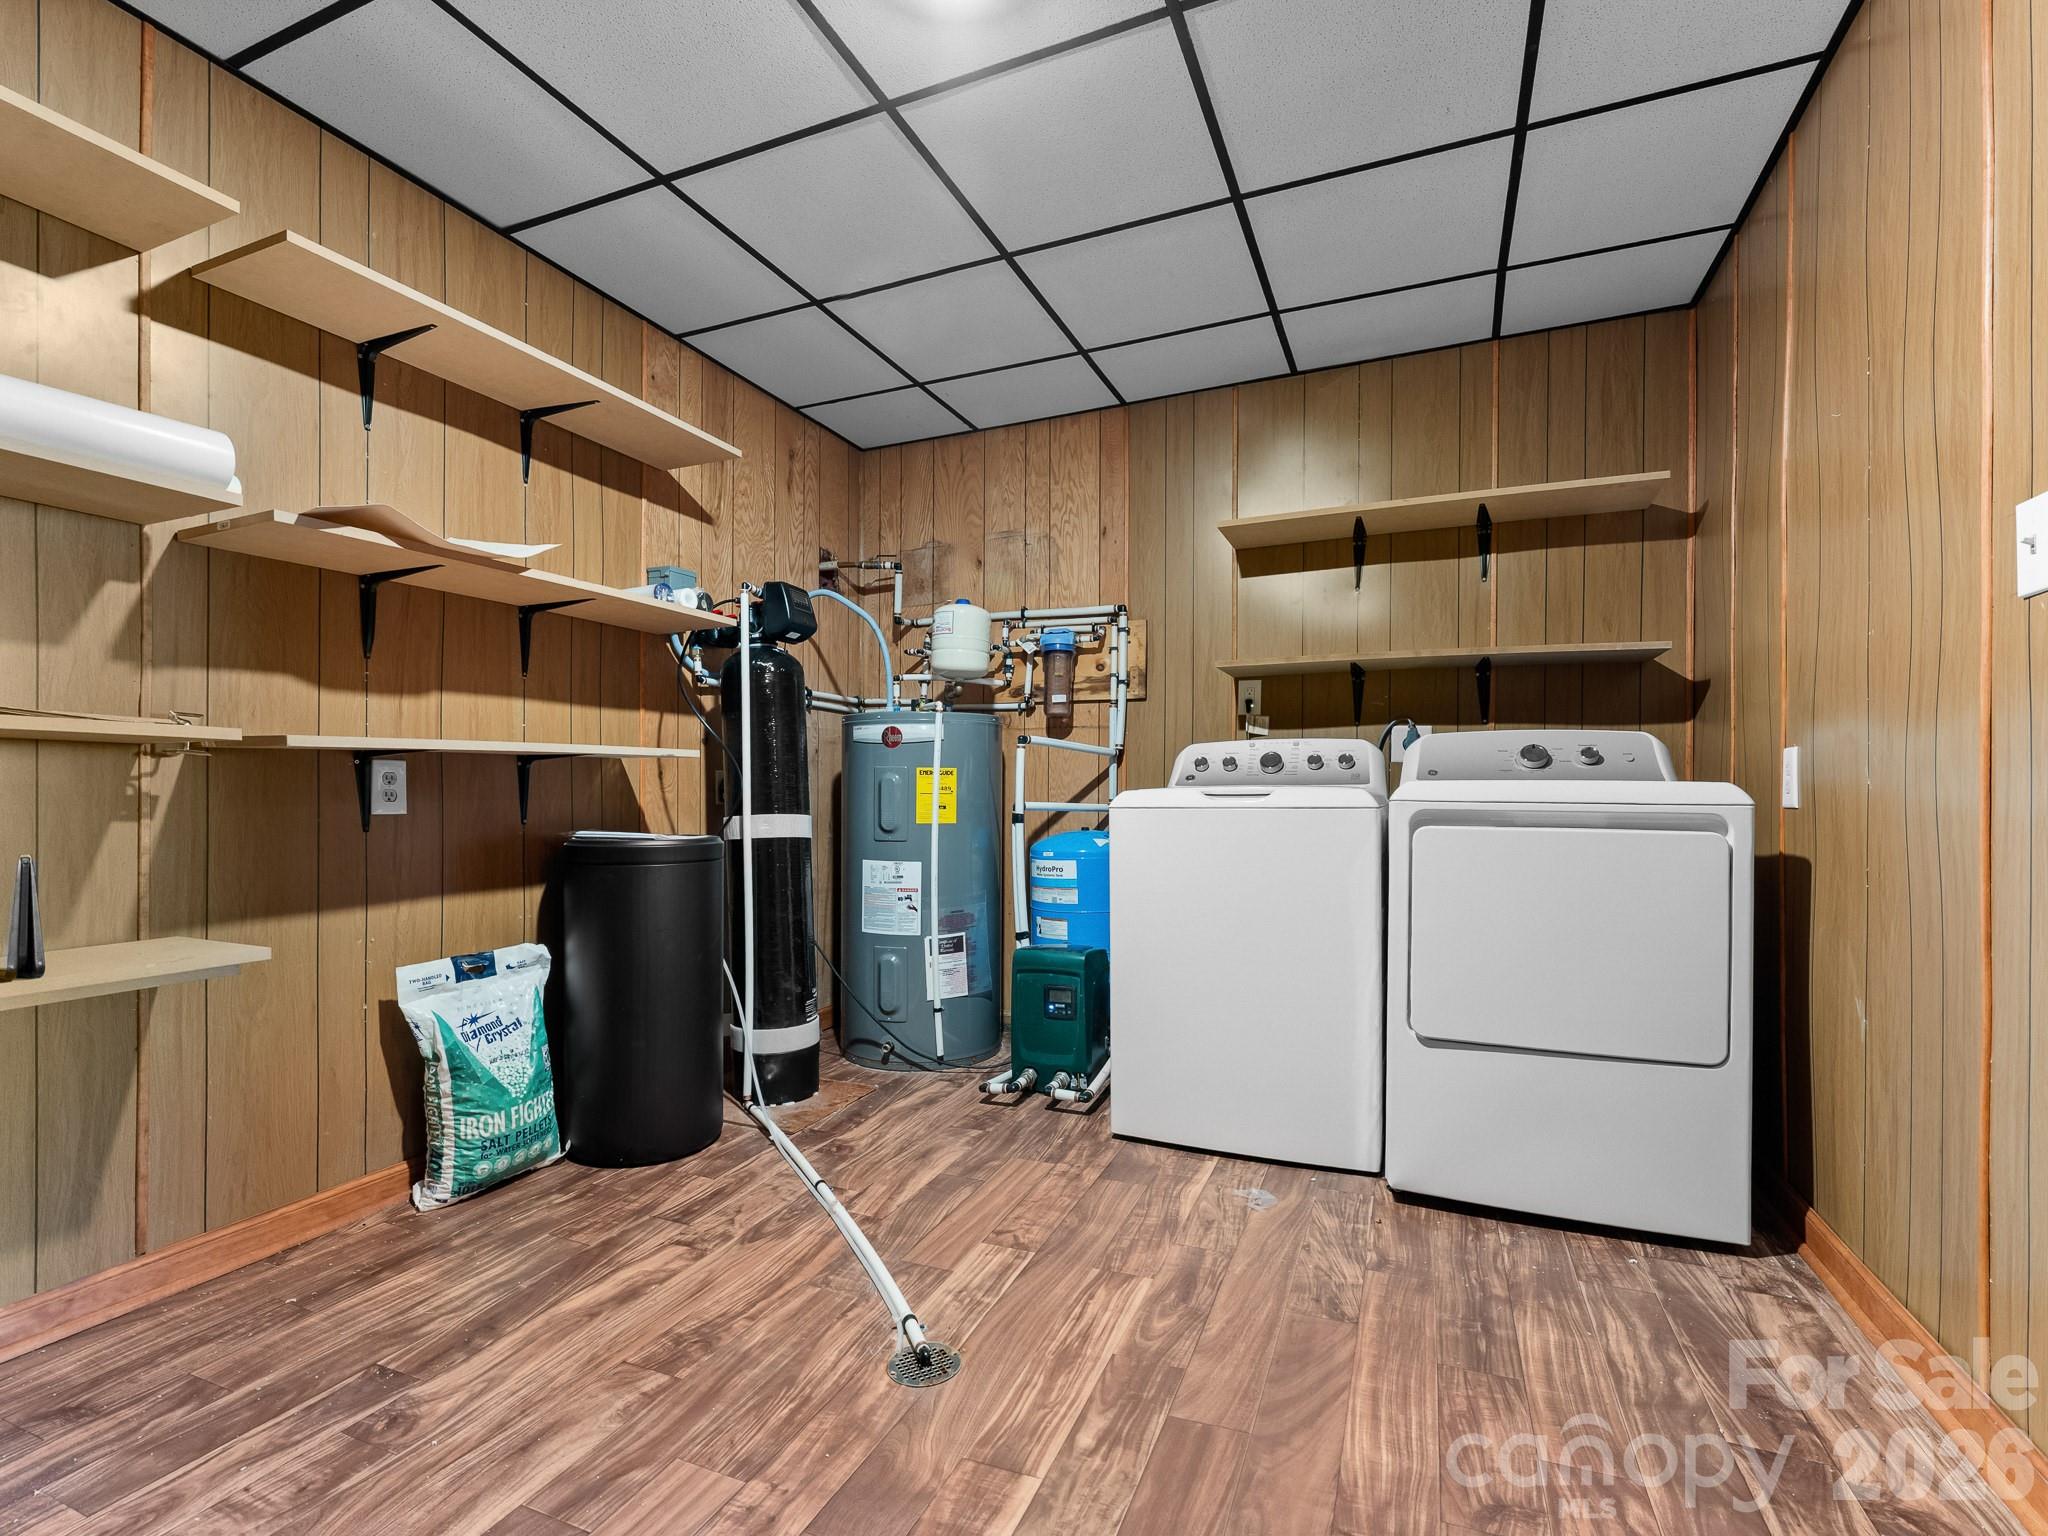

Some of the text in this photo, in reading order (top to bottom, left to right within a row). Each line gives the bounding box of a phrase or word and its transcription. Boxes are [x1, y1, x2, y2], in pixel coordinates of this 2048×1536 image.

[1036, 865, 1064, 873] HydroPro
[461, 1015, 503, 1043] Diamond
[485, 1017, 523, 1044] Crystal
[461, 1110, 506, 1139] IRON
[480, 1114, 552, 1151] SALT PELLETS
[496, 1141, 521, 1156] WATER
